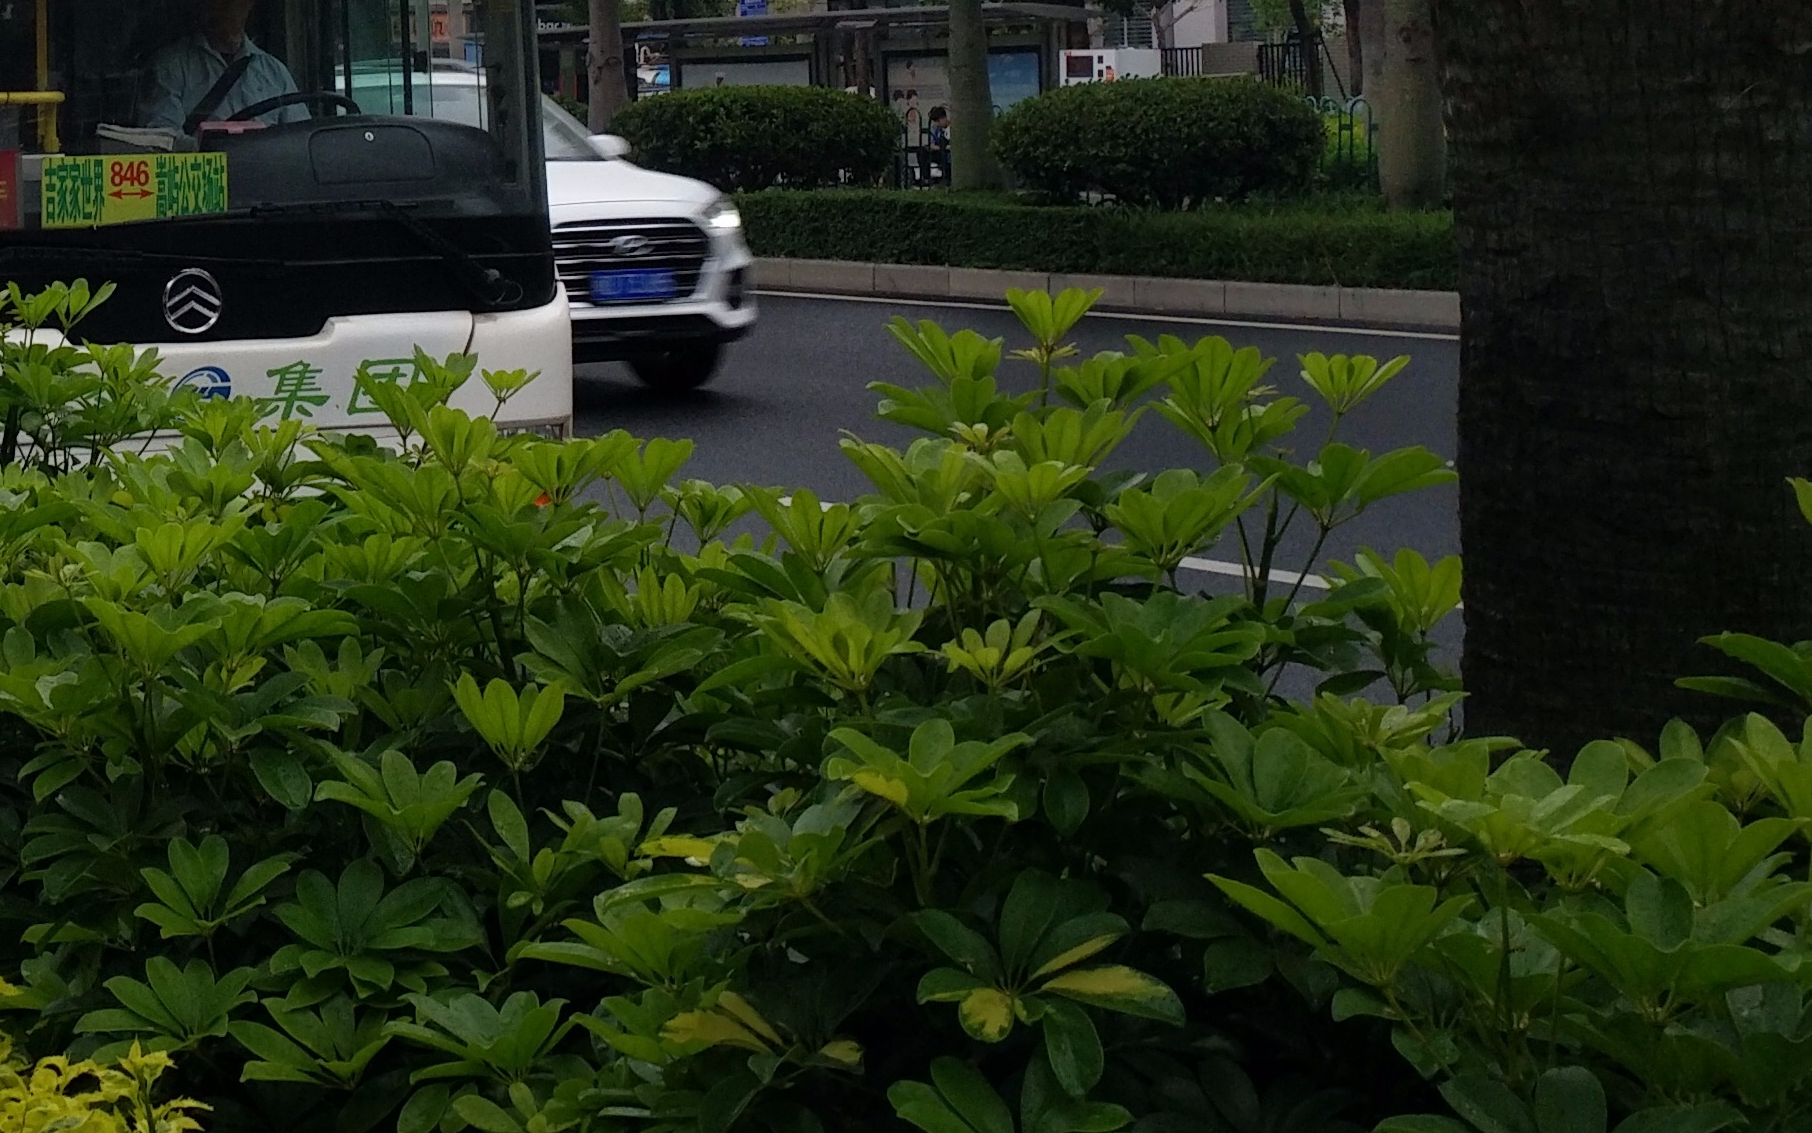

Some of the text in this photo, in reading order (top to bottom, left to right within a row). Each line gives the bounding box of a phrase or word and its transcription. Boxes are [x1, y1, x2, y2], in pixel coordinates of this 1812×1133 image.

[45, 154, 225, 225] 吉家家世界 846 嵩屿公交场站
[253, 358, 423, 421] 集团
